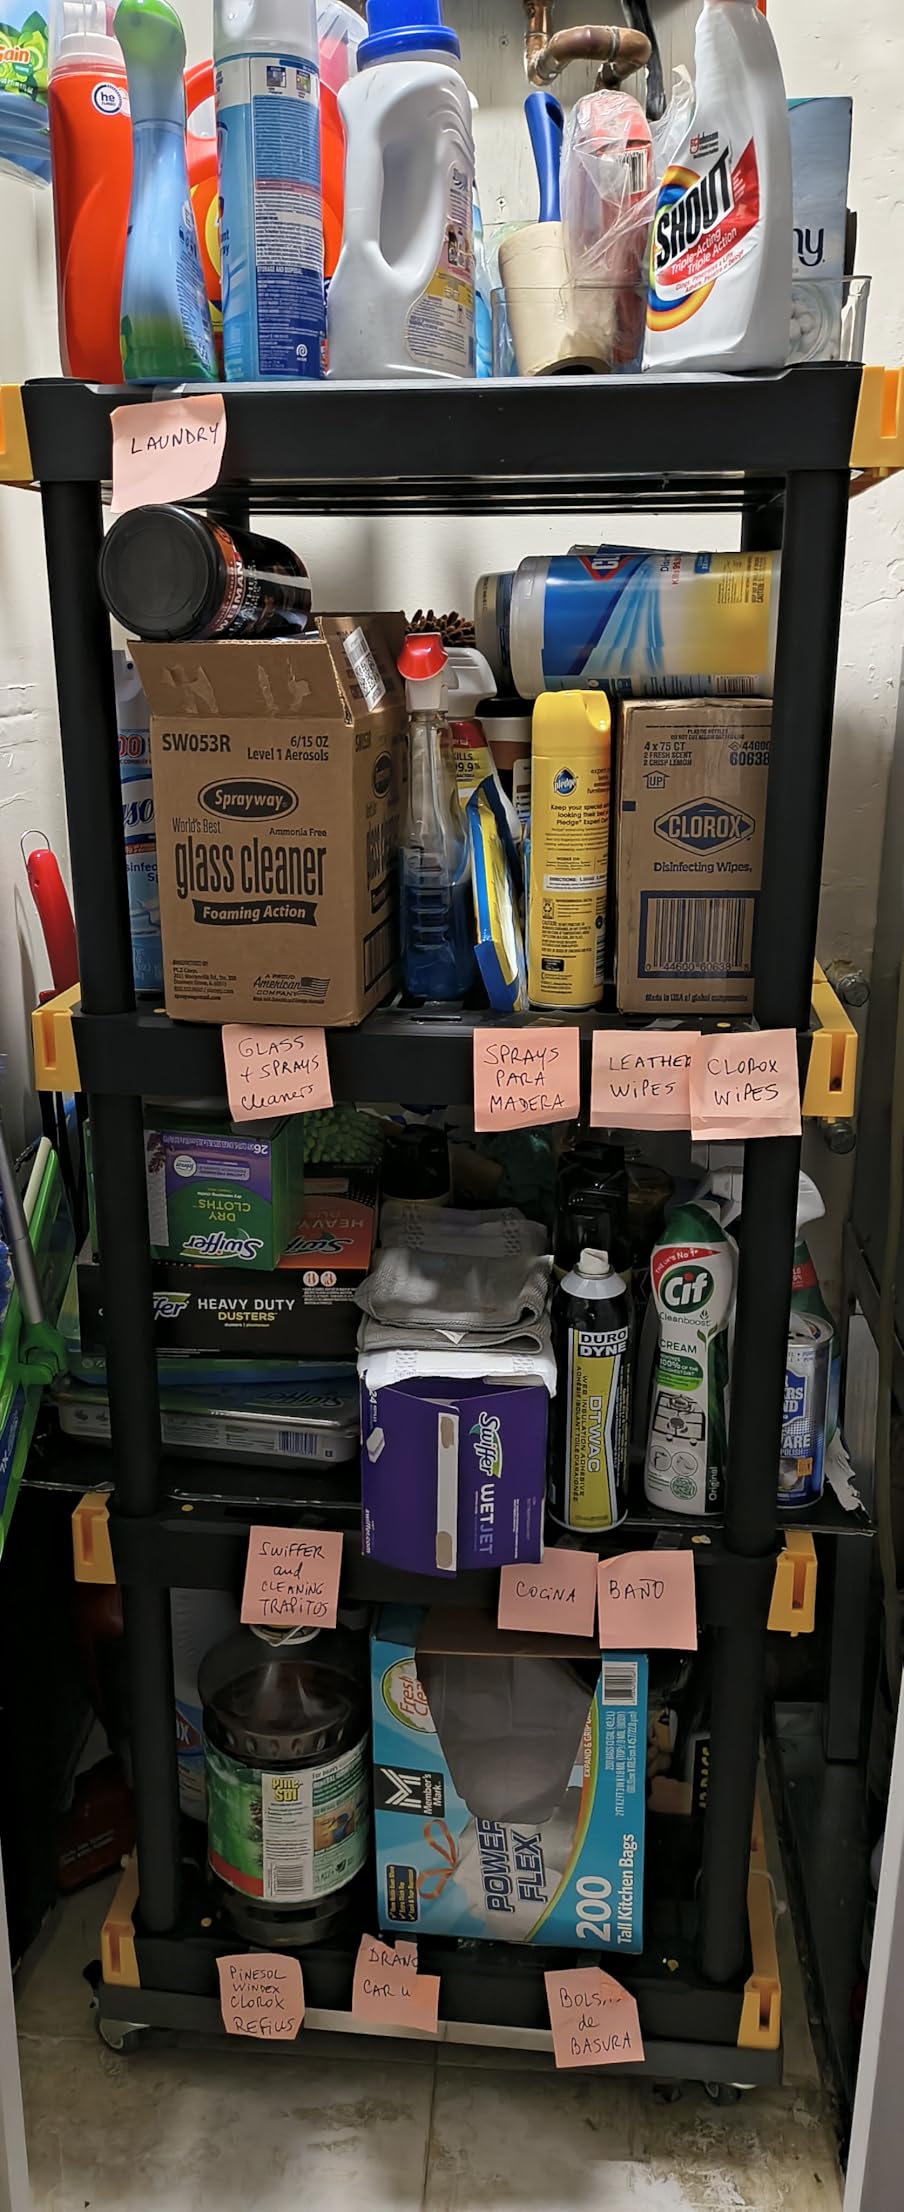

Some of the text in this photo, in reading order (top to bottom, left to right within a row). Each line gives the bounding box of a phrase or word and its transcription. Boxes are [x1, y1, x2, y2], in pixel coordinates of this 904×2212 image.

[100, 91, 116, 103] he
[656, 145, 731, 269] SHOUT
[671, 228, 721, 275] Triple-Acting
[687, 228, 737, 275] Triple Action
[131, 422, 219, 454] LAUNDRY
[215, 560, 244, 632] WEIMAN
[162, 733, 231, 752] SW053R
[290, 736, 328, 748] 6/15 OZ
[644, 742, 650, 751] 4
[660, 742, 671, 751] 75
[674, 742, 686, 751] CT
[247, 748, 329, 761] Level 1 Aerosols
[729, 751, 770, 766] 60638
[649, 776, 663, 787] UP
[215, 789, 284, 811] Sprayway
[550, 804, 567, 812] Keep
[172, 818, 221, 835] World's Best
[269, 827, 327, 837] Ammonia Free
[668, 814, 743, 839] CLOROX
[175, 836, 234, 899] glass
[240, 837, 327, 896] cleaner
[653, 862, 715, 874] Disinfecting
[203, 904, 306, 922] Foaming Action
[253, 975, 300, 990] American
[256, 989, 298, 997] COMPANY
[238, 1035, 304, 1058] GLASS
[483, 1043, 560, 1071] SPRAYS
[609, 1054, 692, 1072] LEATHER
[259, 1054, 319, 1079] SPRAYS
[707, 1057, 779, 1076] CLOROX
[496, 1069, 546, 1087] PARA
[490, 1093, 565, 1114] MADERA
[253, 1143, 269, 1155] 26
[198, 1199, 251, 1212] CLOTHS
[208, 1212, 236, 1223] DRY
[183, 1230, 264, 1260] Swiffer
[664, 1272, 708, 1306] Cif
[197, 1298, 295, 1311] HEAVY DUTY
[218, 1312, 275, 1321] DUSTERS
[660, 1311, 710, 1327] Cleanboost
[581, 1330, 627, 1344] DURO
[580, 1341, 626, 1356] DYNE
[660, 1340, 697, 1354] CREAM
[660, 1358, 681, 1370] 100%
[369, 1390, 378, 1404] 24
[587, 1395, 602, 1473] DTWAC
[474, 1411, 501, 1477] Swiffer
[708, 1466, 720, 1501] Original
[274, 1562, 303, 1579] and
[399, 1676, 415, 1714] Fresh
[605, 1747, 614, 1760] BAGS
[583, 1748, 592, 1778] EXPAND
[423, 1773, 433, 1815] Member's
[618, 1833, 638, 1867] Bags
[511, 1830, 549, 1904] FLEX
[618, 1870, 634, 1921] Kitchen
[575, 1876, 613, 1943] 200
[617, 1921, 633, 1945] Tall
[363, 1979, 396, 1997] CAR
[579, 2013, 600, 2031] de
[571, 2031, 631, 2055] BASURA
